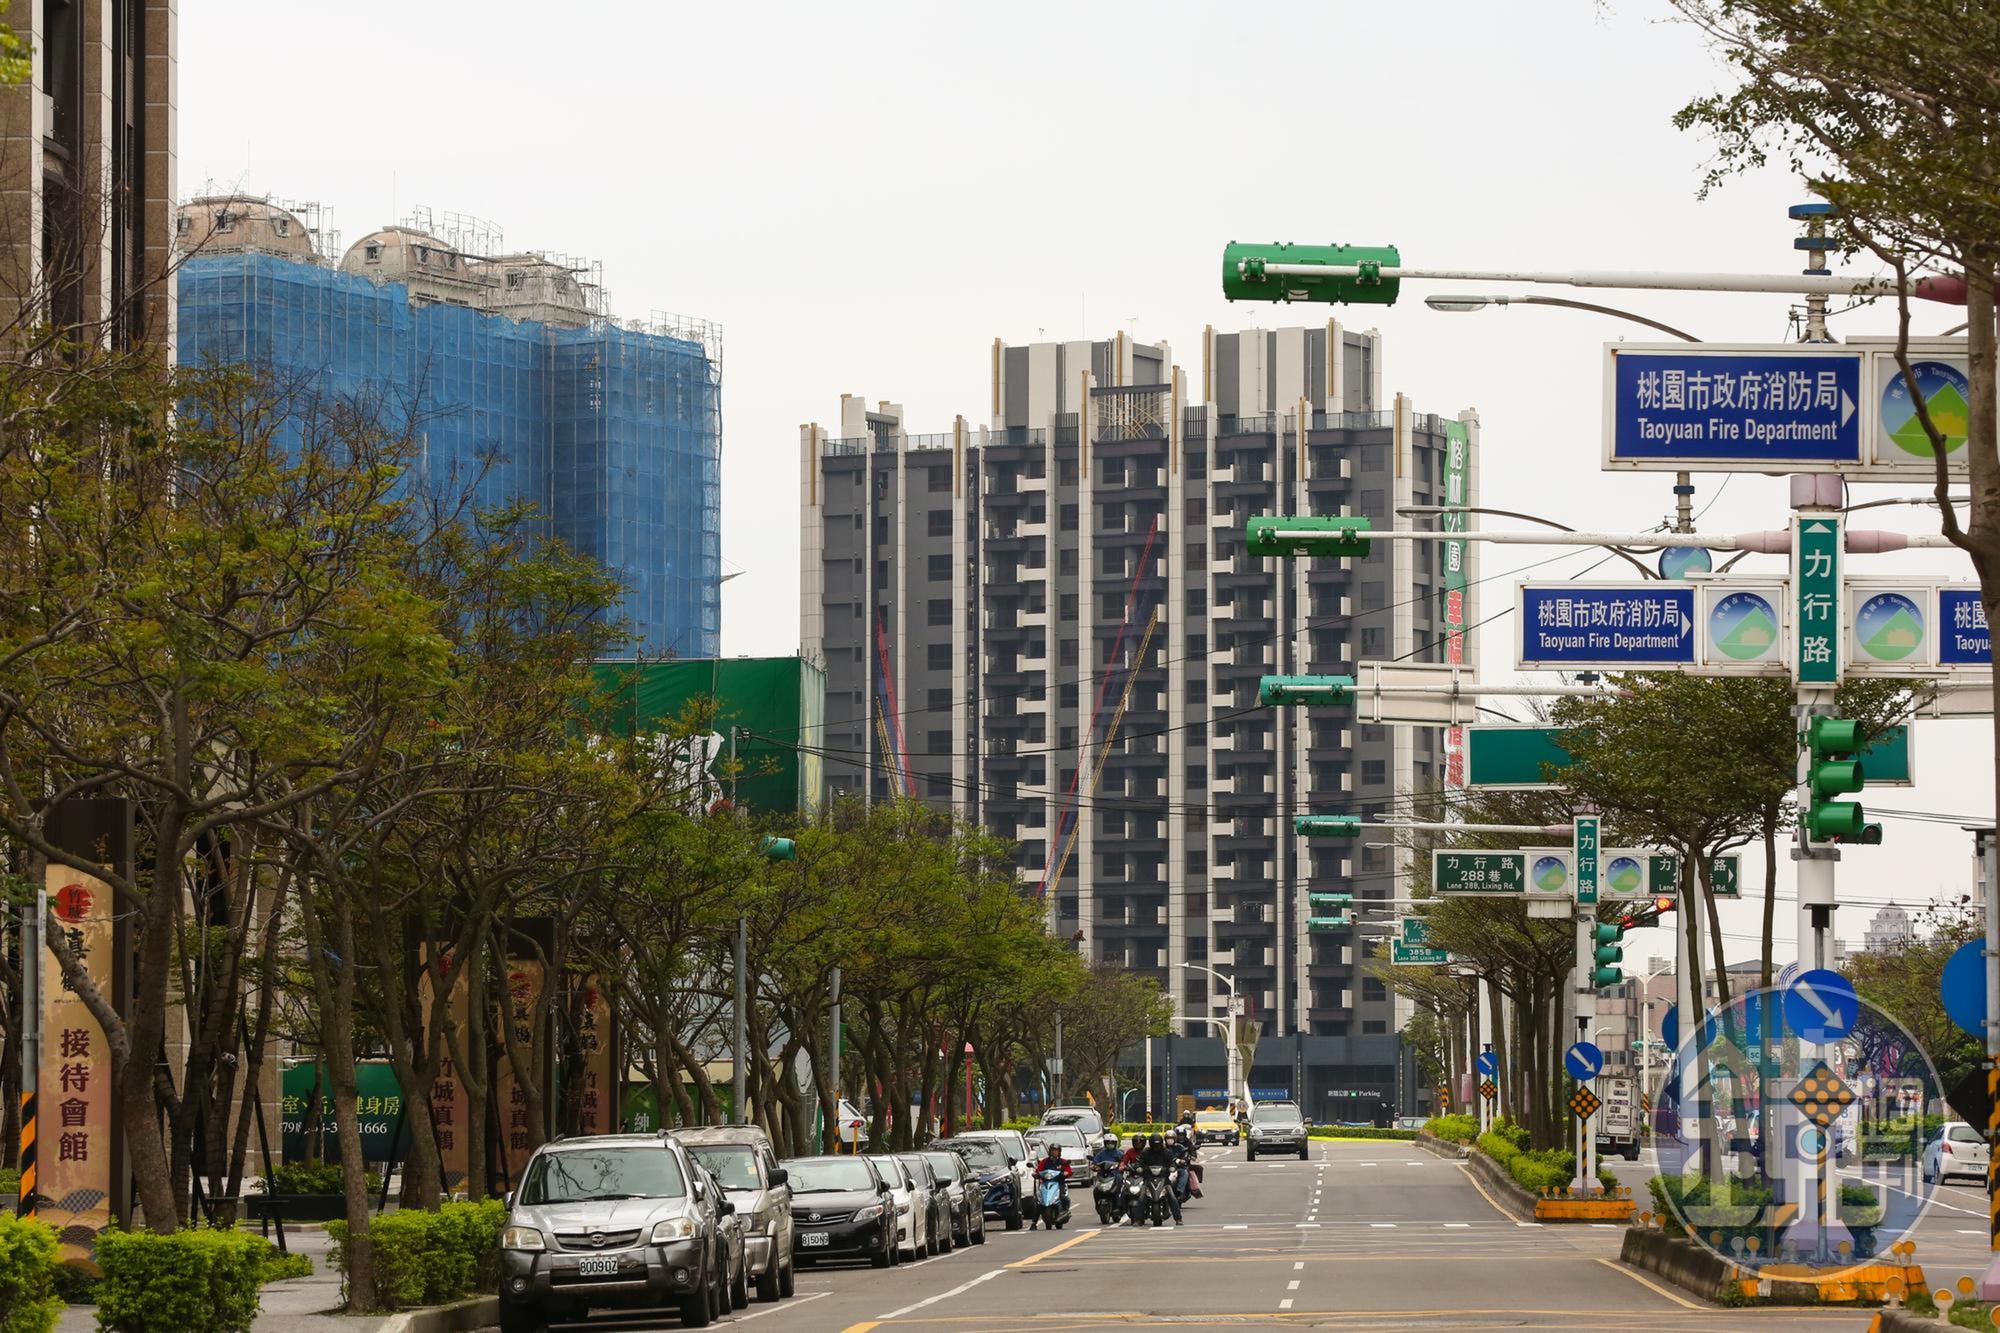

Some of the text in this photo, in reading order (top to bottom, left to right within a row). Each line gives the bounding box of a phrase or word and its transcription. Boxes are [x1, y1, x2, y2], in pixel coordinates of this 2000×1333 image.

[1637, 370, 1838, 411] 桃園市政府消防局
[1638, 418, 1837, 445] Taoyuan Fire Department
[1538, 599, 1679, 628] 桃園市政府消防局
[1803, 549, 1832, 663] 力行路
[1539, 633, 1679, 651] Taoyuan Fire Department
[1448, 857, 1514, 869] 力行路
[1580, 834, 1595, 893] 力行路
[1482, 882, 1502, 890] Lixing
[59, 1029, 90, 1162] 接待會館
[1359, 1090, 1381, 1098] Parking
